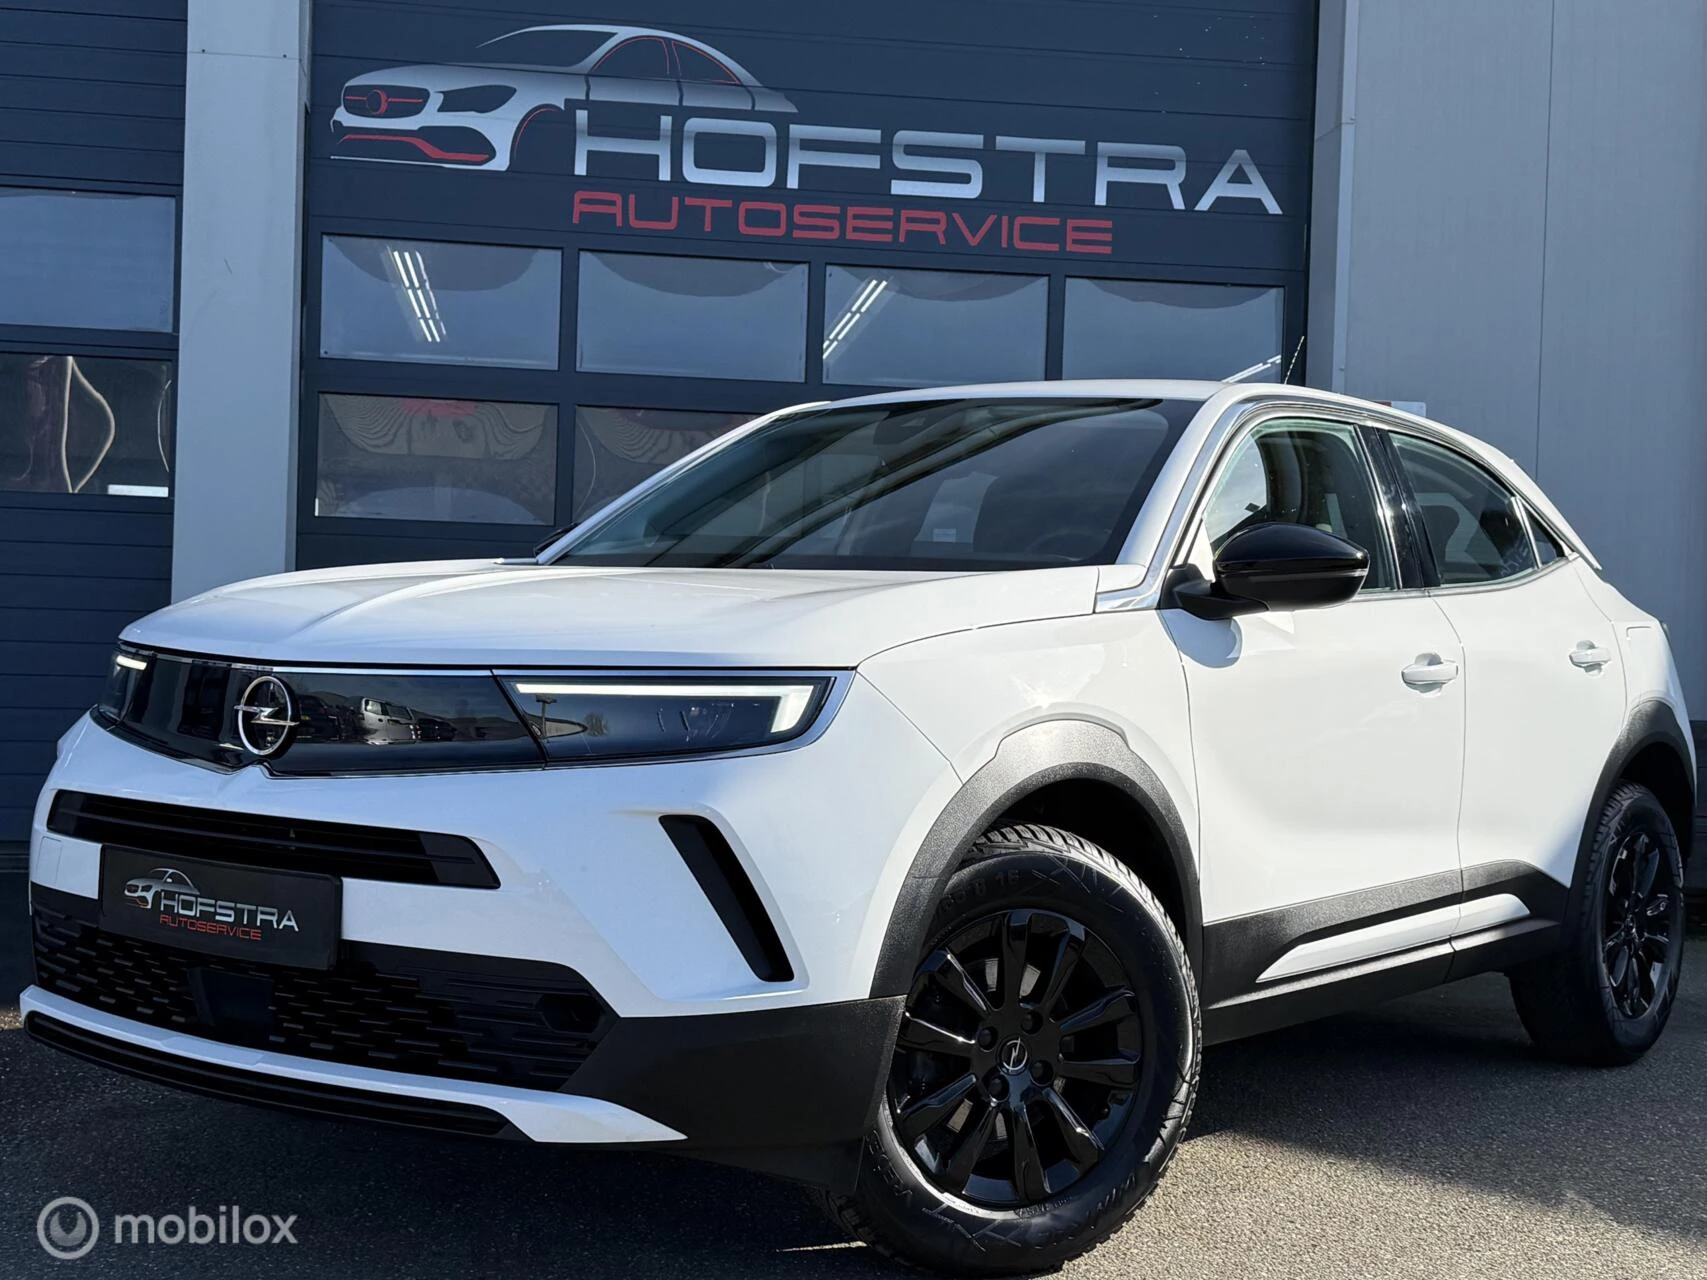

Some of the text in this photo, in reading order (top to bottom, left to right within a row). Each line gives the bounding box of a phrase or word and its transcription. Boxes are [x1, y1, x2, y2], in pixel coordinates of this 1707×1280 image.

[573, 109, 1283, 215] HOFSTRA
[572, 190, 1113, 255] AUTOSERVICE
[159, 914, 262, 941] AUTOSERVICE
[160, 891, 299, 932] HOFSTRA
